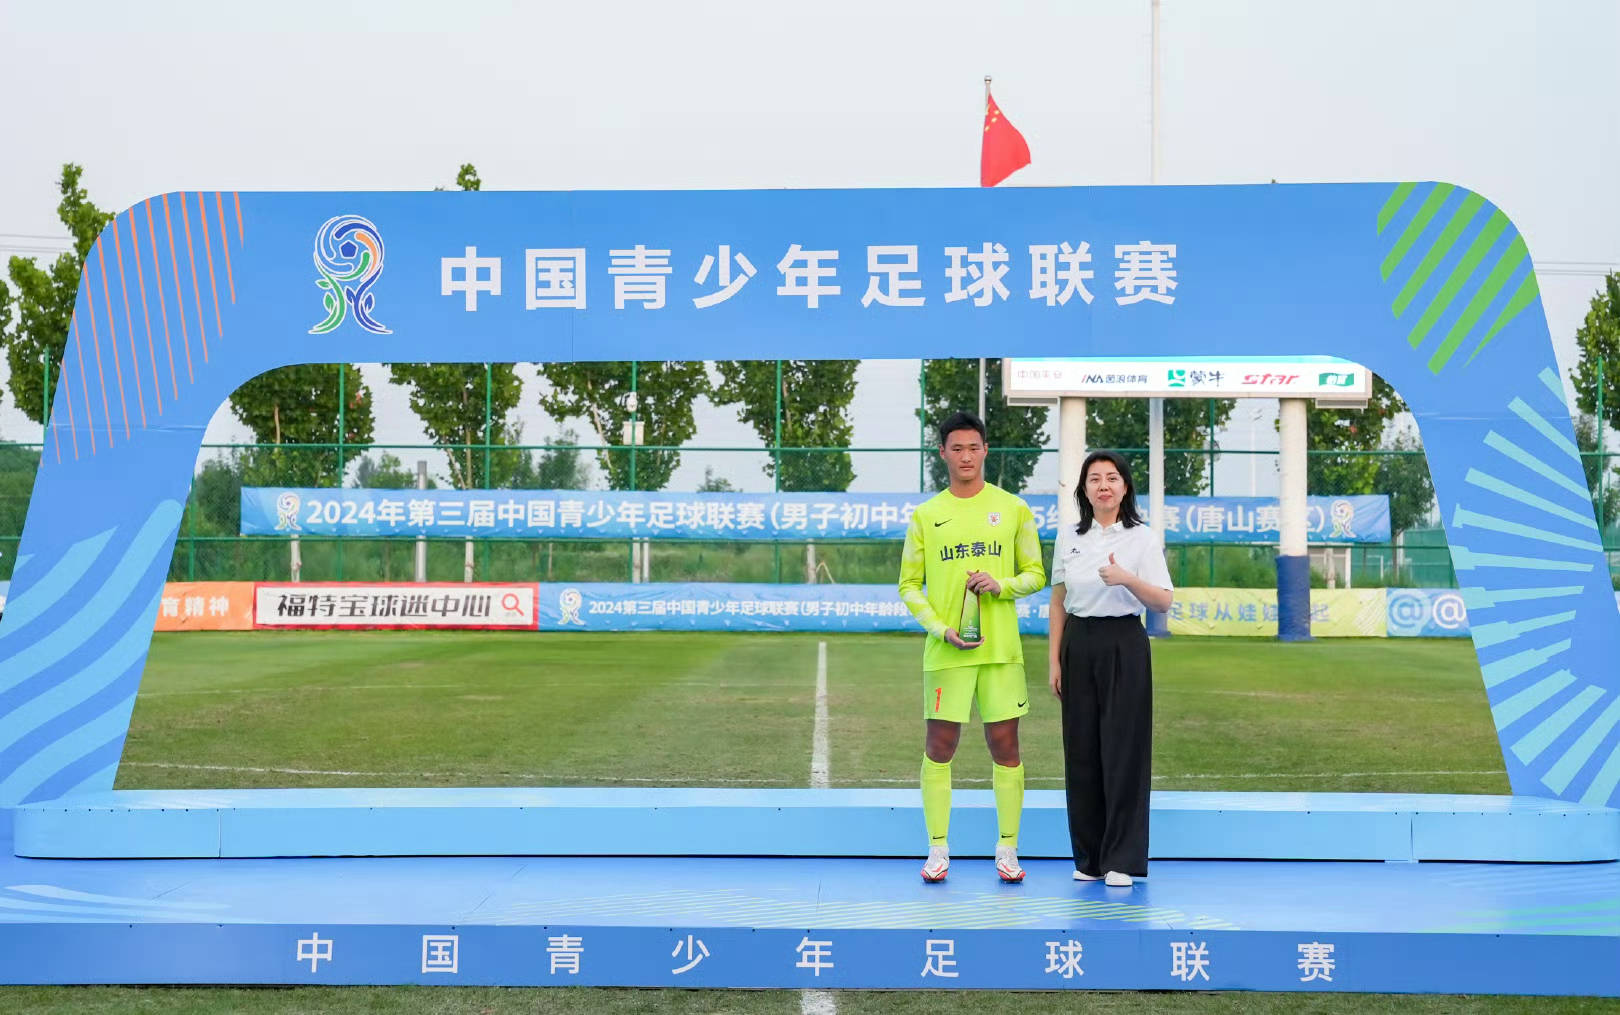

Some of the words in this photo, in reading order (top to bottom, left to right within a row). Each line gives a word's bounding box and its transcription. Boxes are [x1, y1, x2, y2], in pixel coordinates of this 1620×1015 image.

[440, 241, 1178, 311] 中国青少年足球联赛
[940, 540, 1002, 561] 山东泰山
[277, 594, 491, 618] 福特宝球迷中心
[935, 687, 943, 713] 1
[296, 932, 1336, 982] 中国青少年足球联赛
